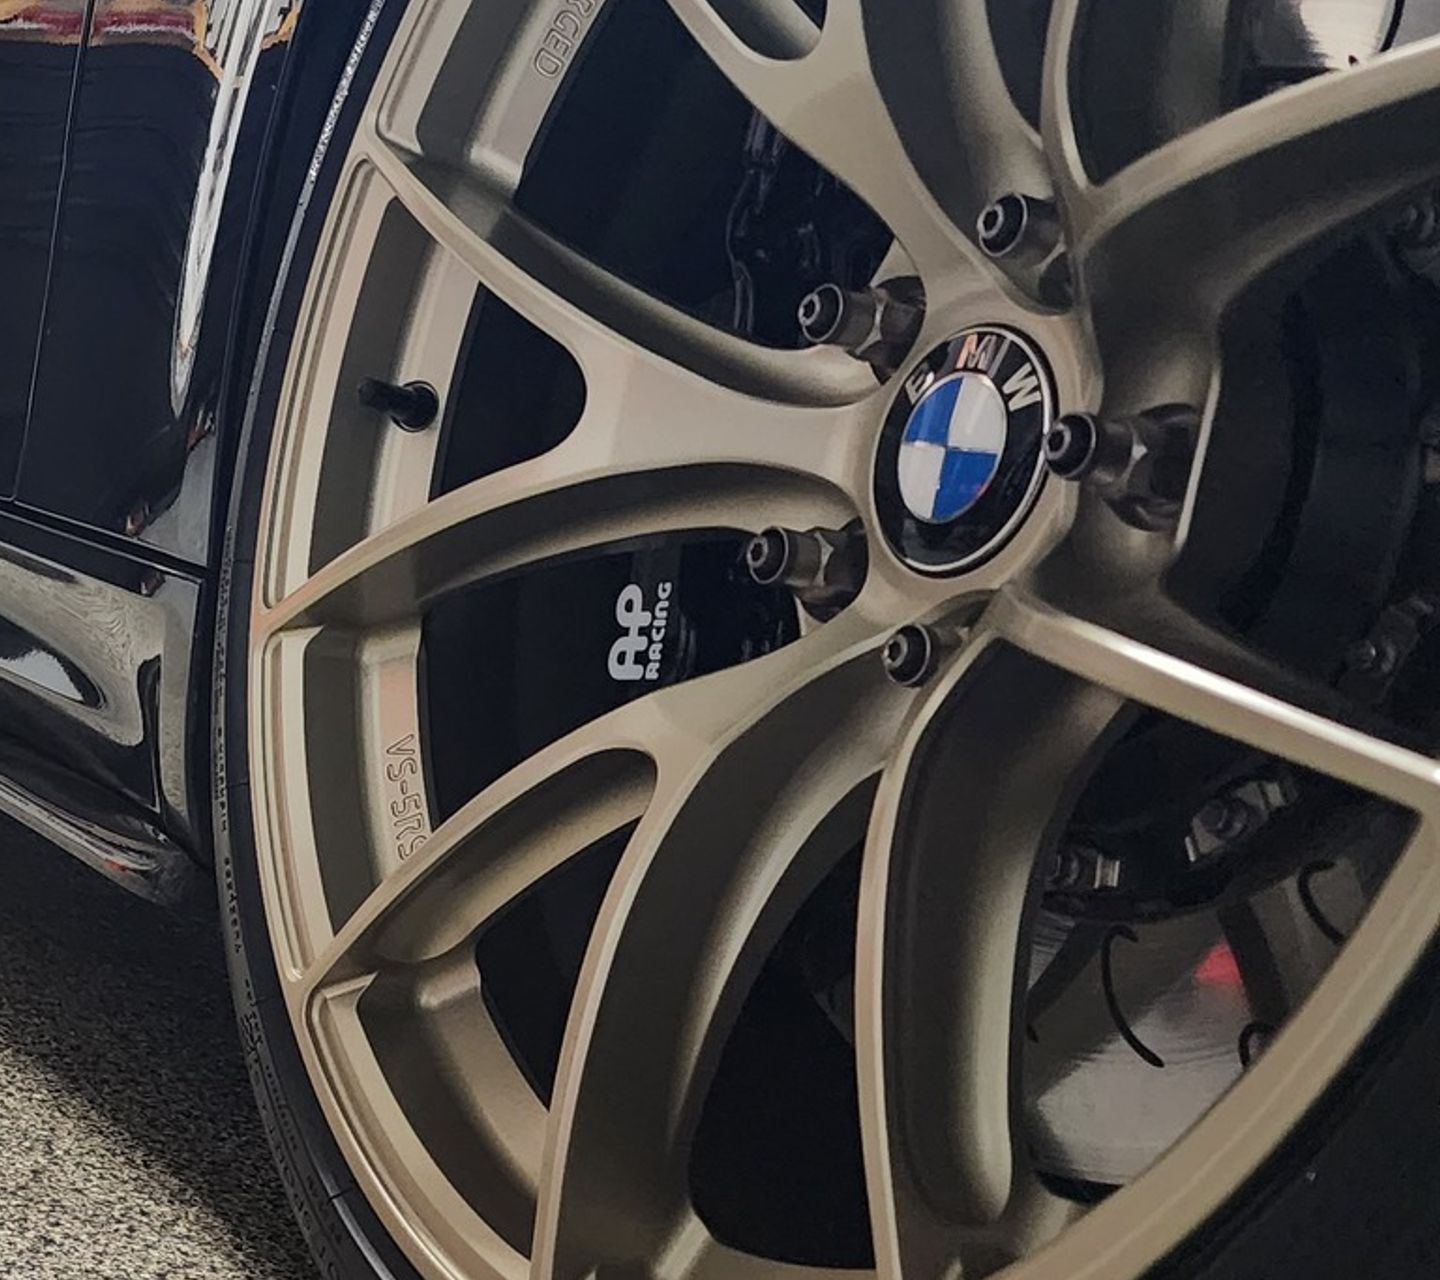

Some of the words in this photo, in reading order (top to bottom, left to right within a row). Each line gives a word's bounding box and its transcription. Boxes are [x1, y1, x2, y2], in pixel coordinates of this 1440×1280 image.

[904, 332, 1043, 413] BMW
[607, 583, 652, 681] AP
[644, 581, 673, 681] RACING
[386, 733, 428, 862] VS-5RS
